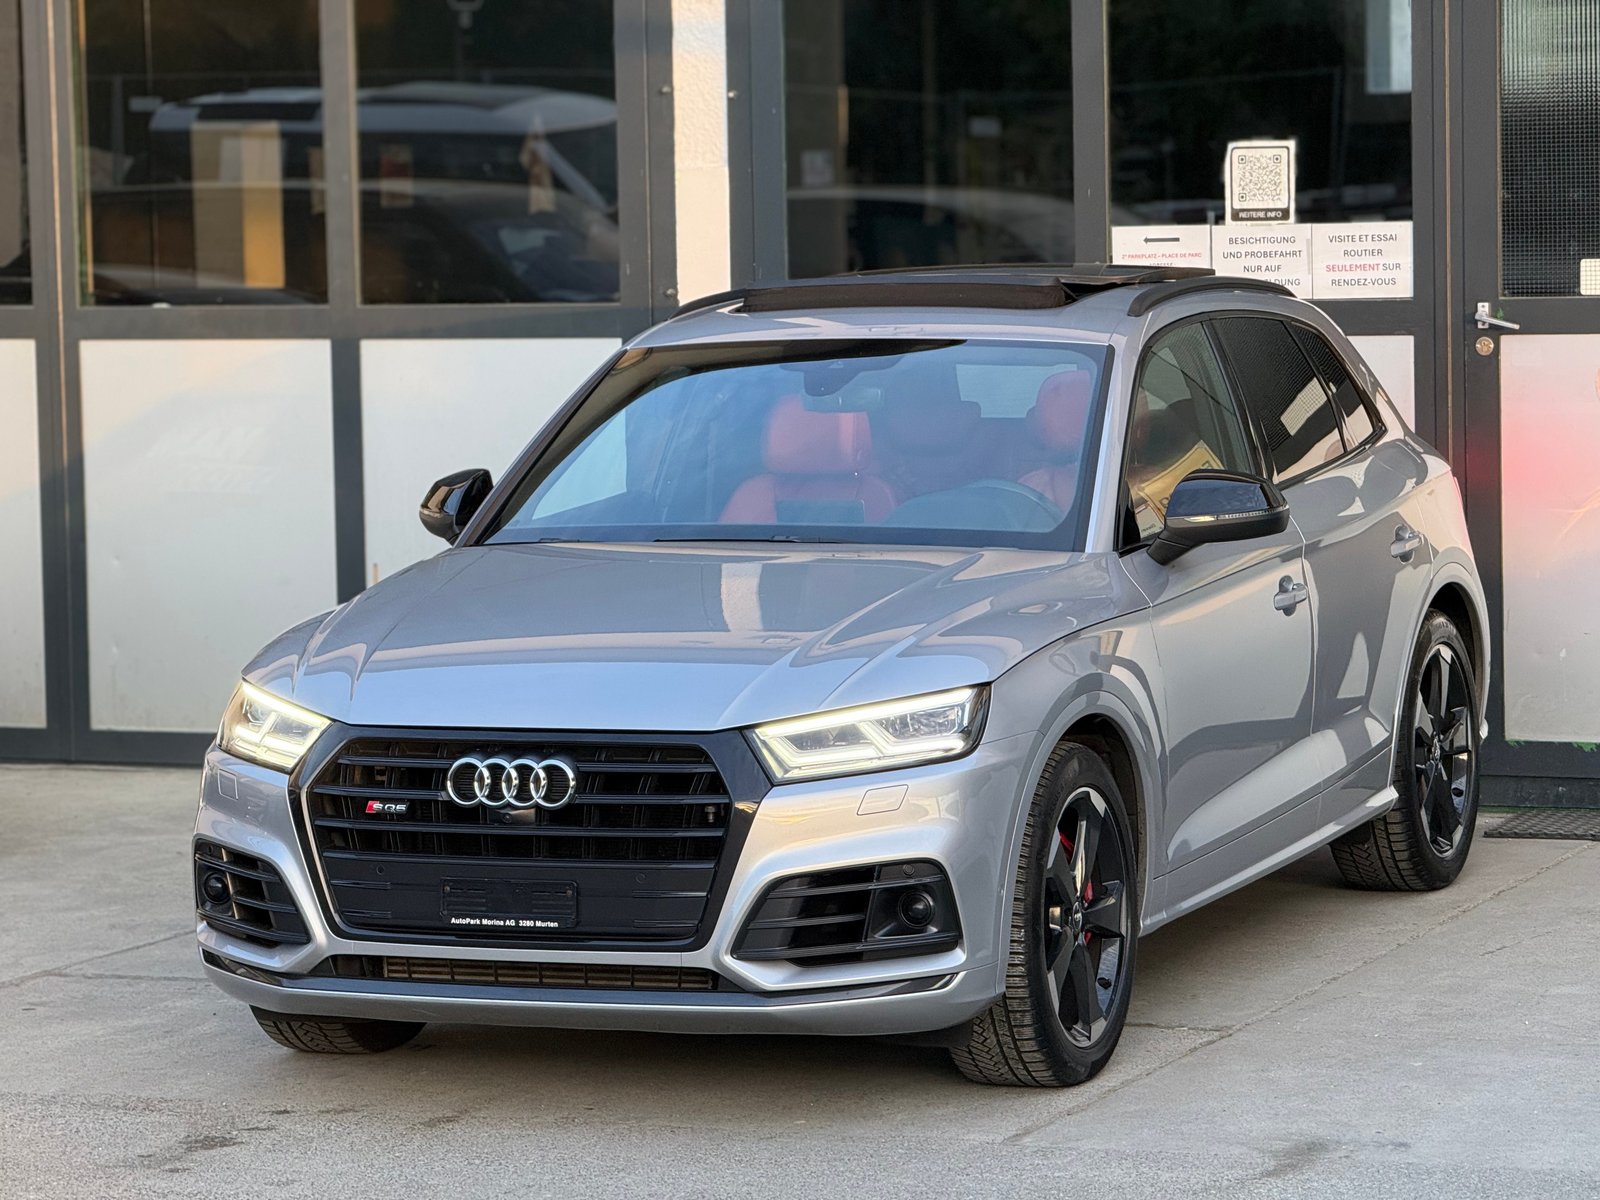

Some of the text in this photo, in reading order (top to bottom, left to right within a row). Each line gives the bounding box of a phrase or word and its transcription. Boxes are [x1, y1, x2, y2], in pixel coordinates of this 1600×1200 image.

[1228, 236, 1296, 245] BESICHTIGUNG
[1328, 234, 1397, 243] VISITE ET ESSAI
[1222, 250, 1302, 259] UND PROBEFAHRT
[1343, 249, 1383, 257] ROUTIER
[1243, 264, 1282, 273] NUR AUF
[1325, 263, 1401, 272] SEULEMENT SUR
[1331, 278, 1397, 286] RENDEZ-VOUS
[372, 803, 407, 813] SQ5
[450, 917, 480, 925] AutoPark
